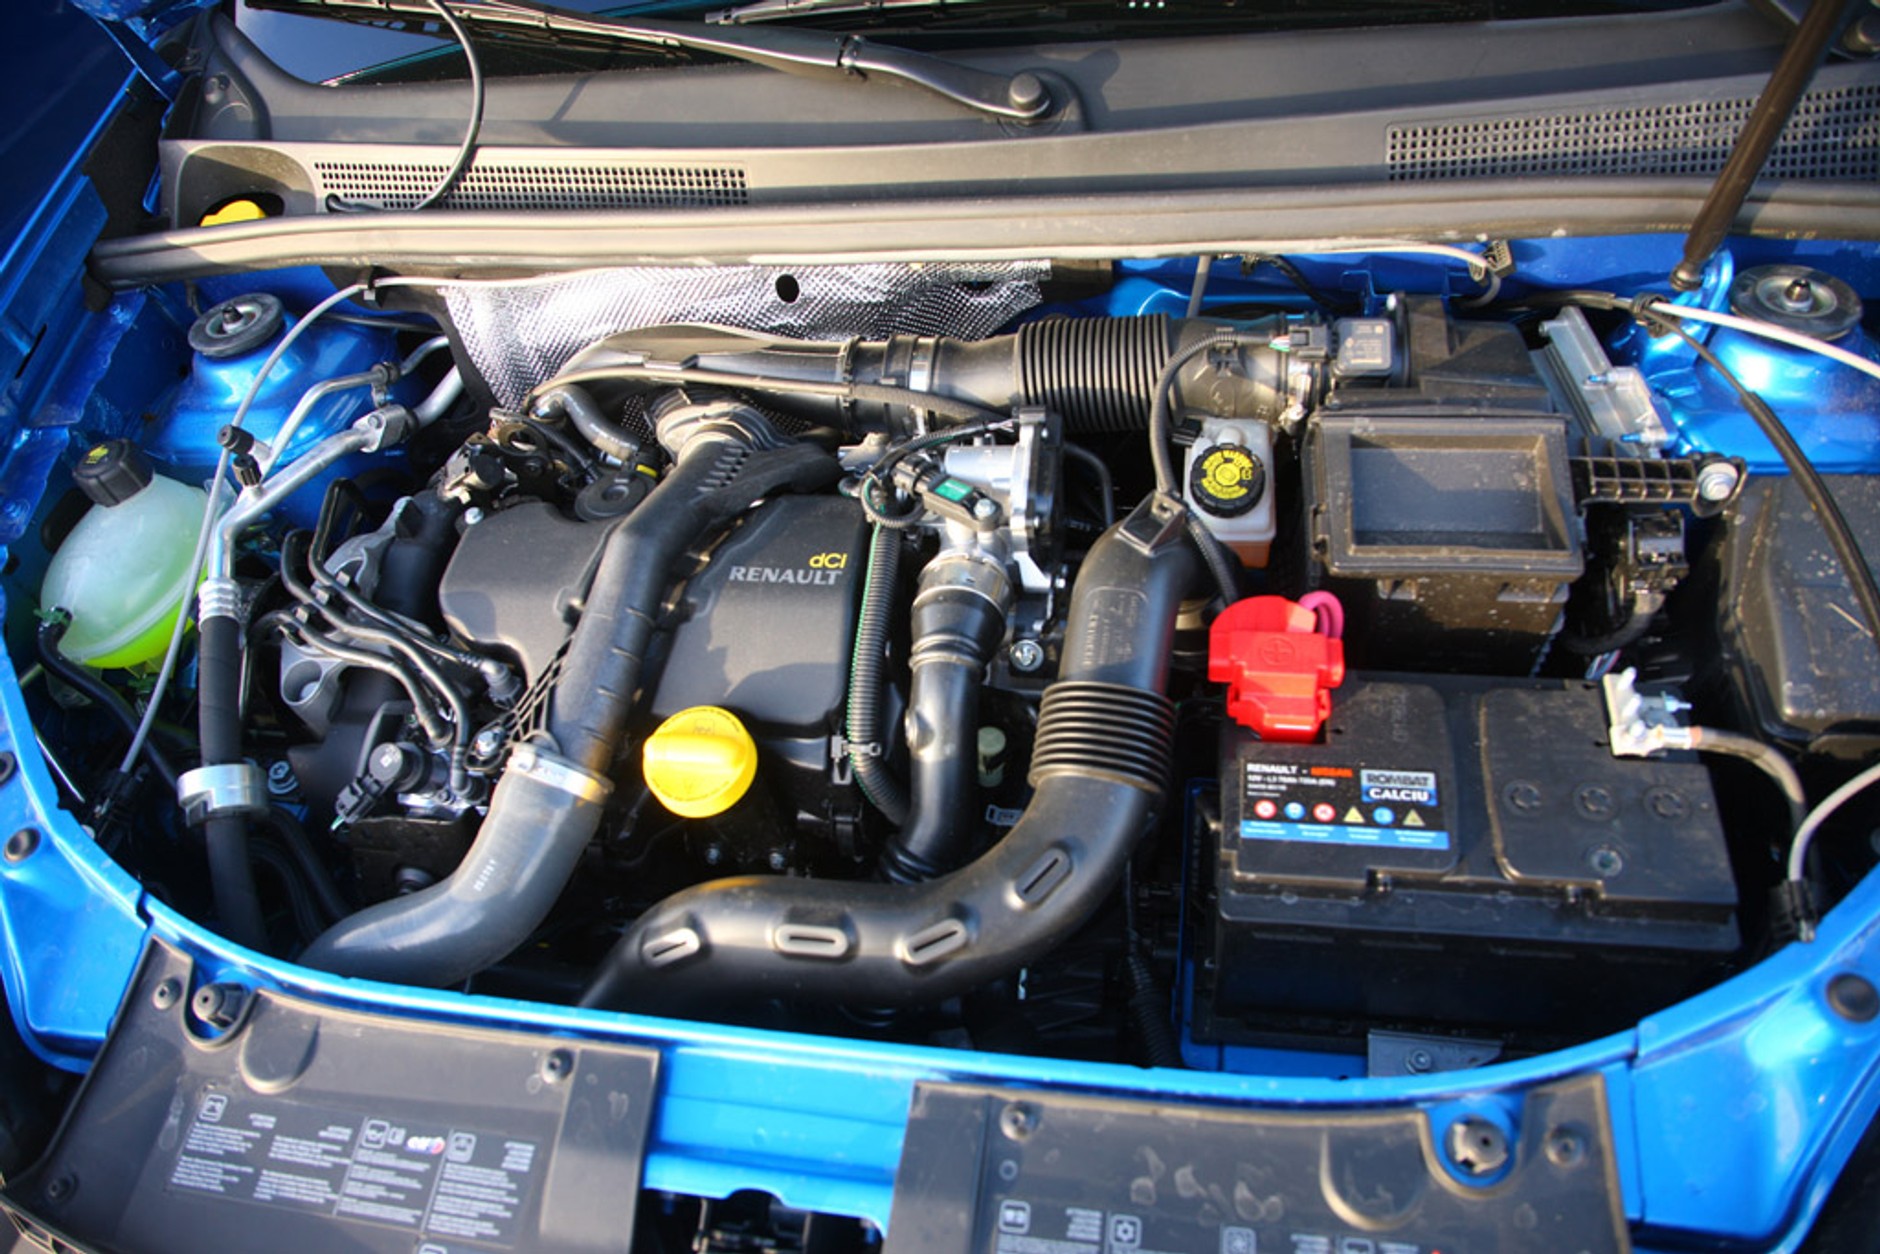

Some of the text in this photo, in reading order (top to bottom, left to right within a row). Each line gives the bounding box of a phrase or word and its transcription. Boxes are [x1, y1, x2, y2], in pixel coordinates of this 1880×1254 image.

[729, 566, 842, 585] RENAULT
[1247, 764, 1297, 774] RENAULT
[1367, 773, 1429, 787] ROMBAT
[1369, 787, 1429, 802] CALCIU
